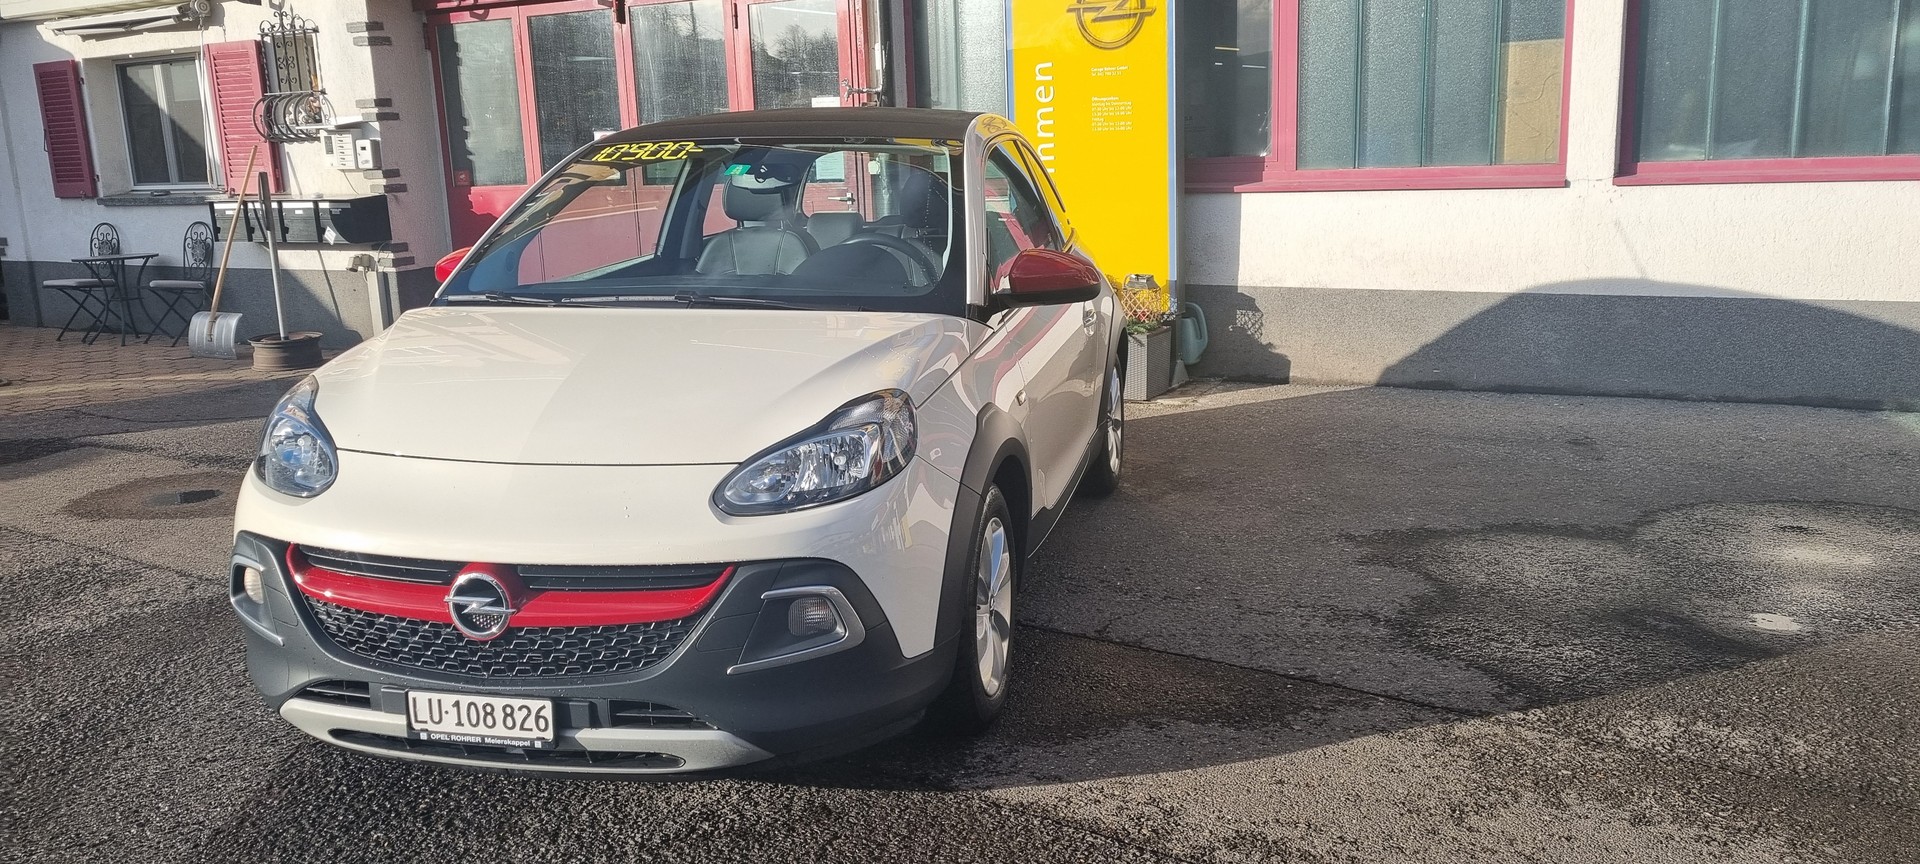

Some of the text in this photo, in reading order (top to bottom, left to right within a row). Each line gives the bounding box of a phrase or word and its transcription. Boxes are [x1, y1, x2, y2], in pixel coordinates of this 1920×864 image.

[430, 733, 531, 748] OPEL ROHRER Meierskappel
